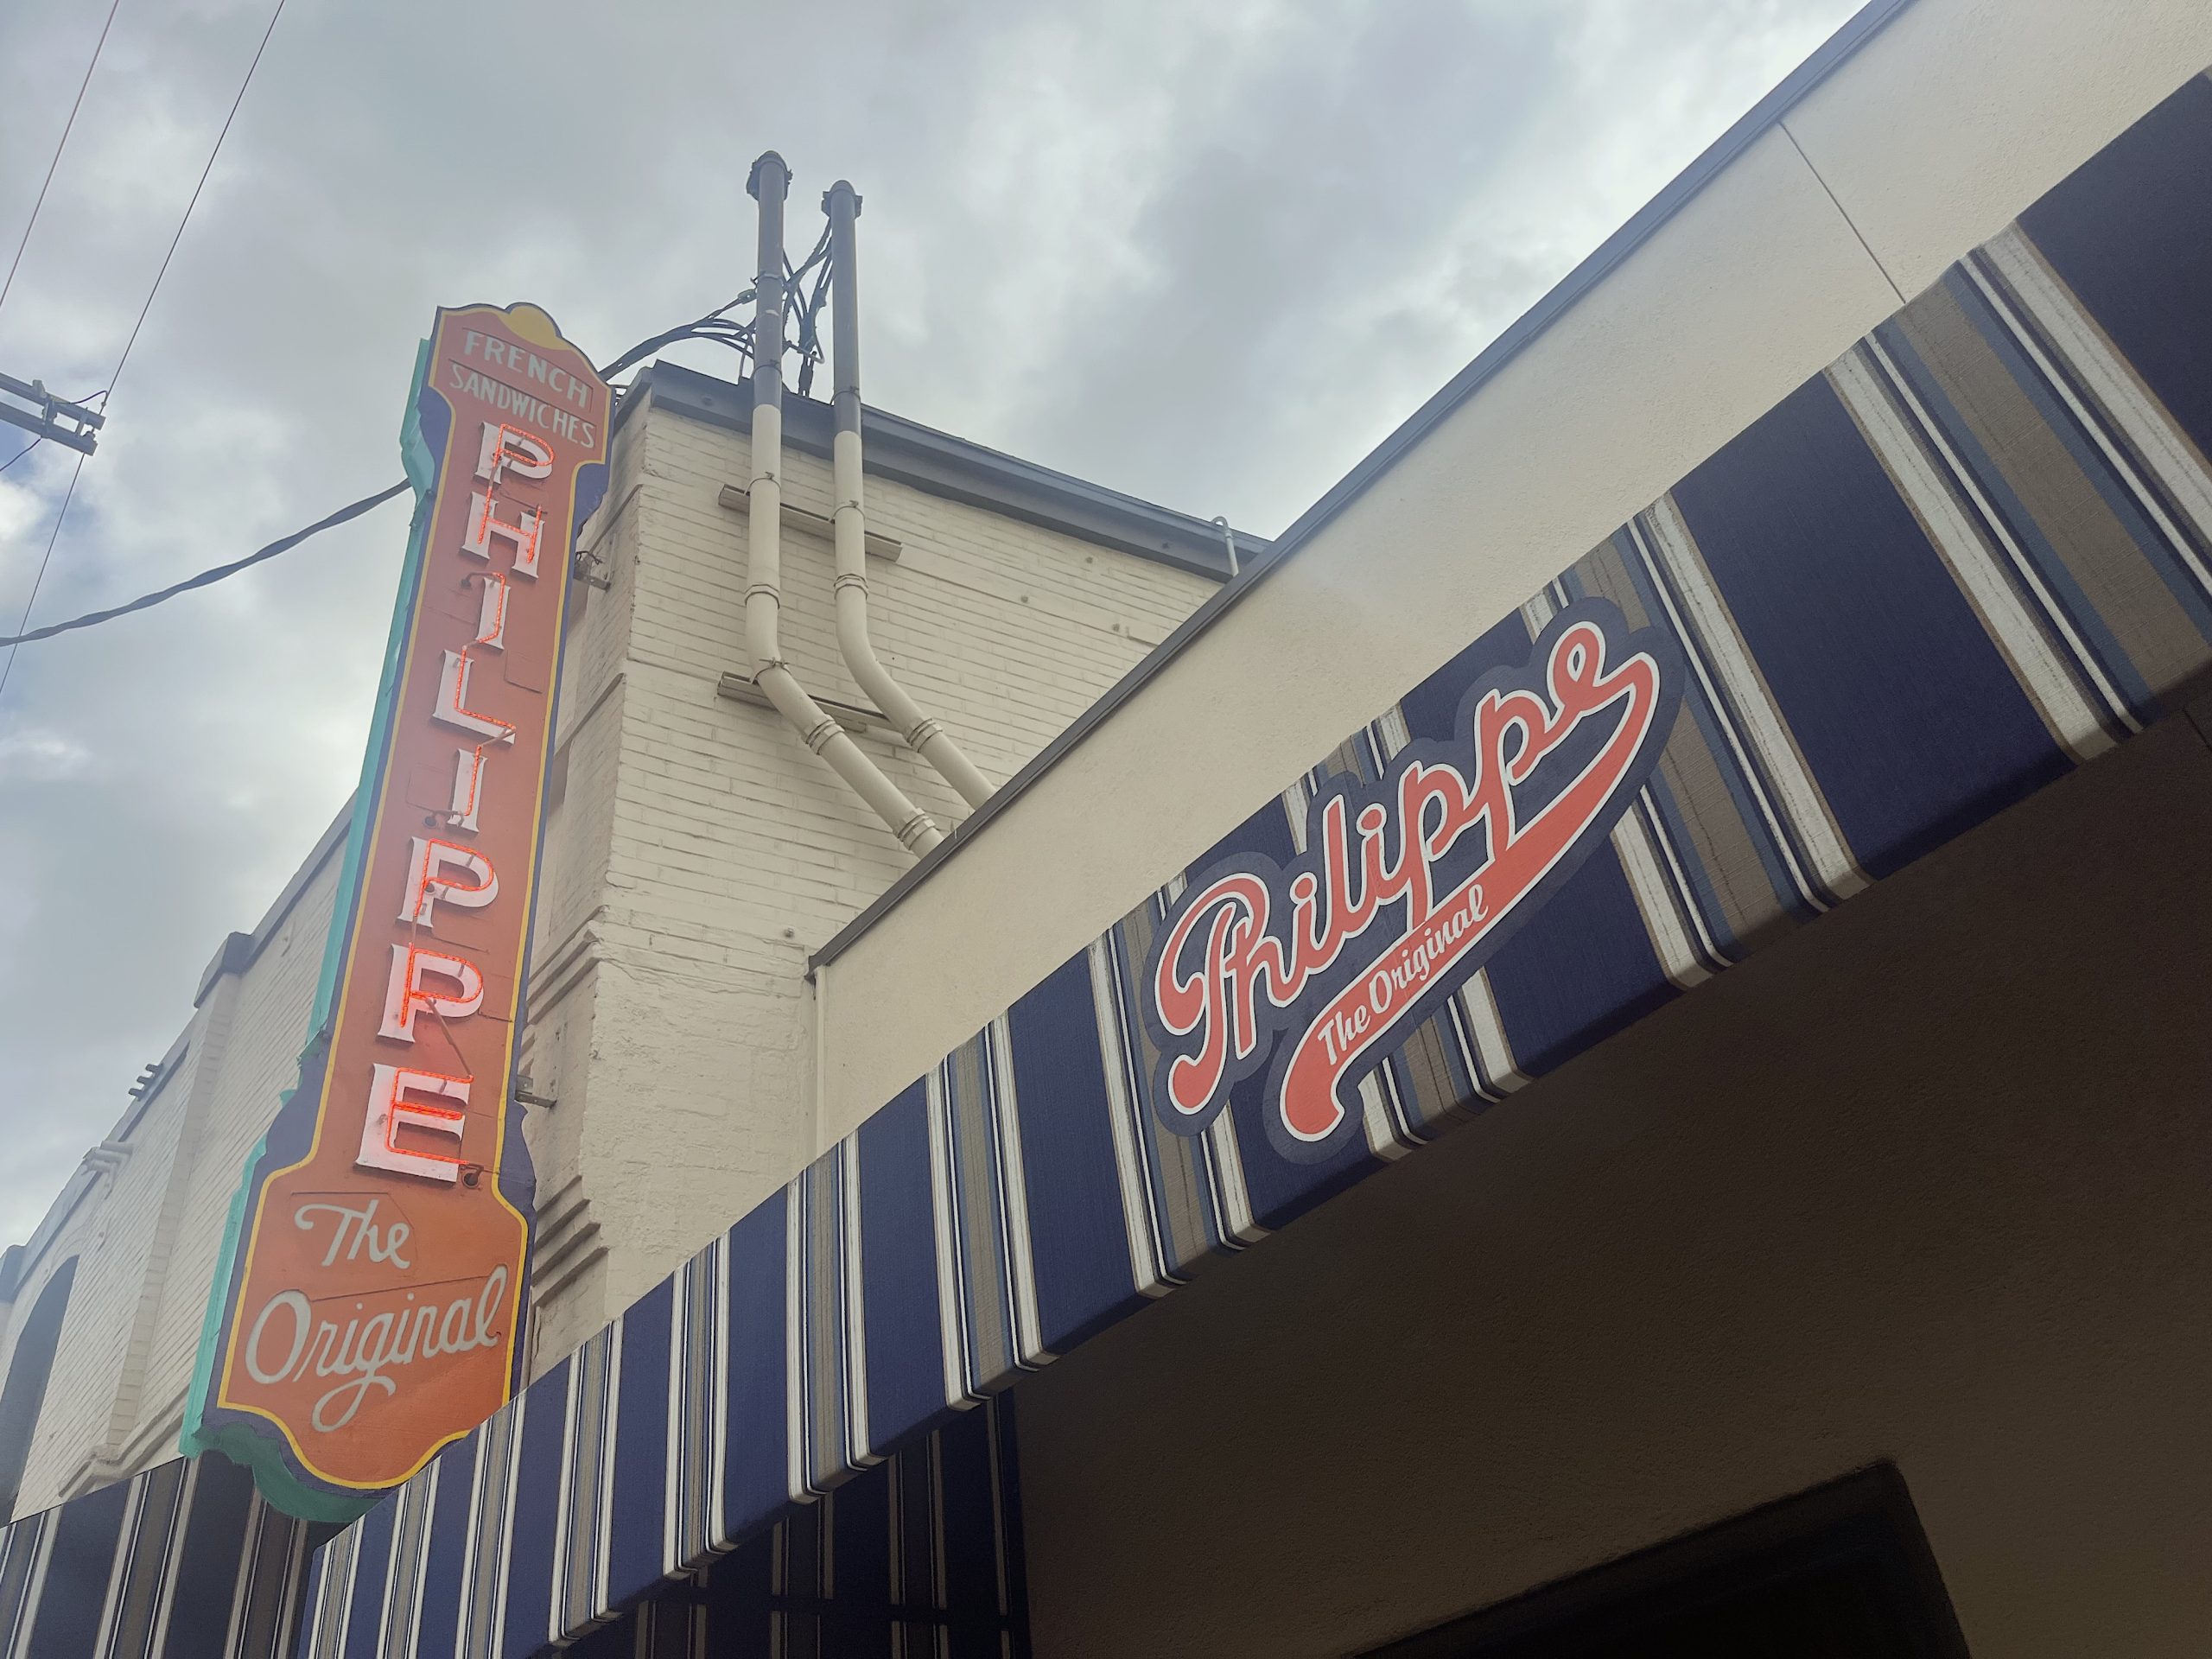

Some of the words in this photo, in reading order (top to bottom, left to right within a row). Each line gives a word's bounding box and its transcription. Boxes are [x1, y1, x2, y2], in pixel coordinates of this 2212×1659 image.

[448, 363, 595, 449] SANDWICHES
[464, 330, 589, 409] FRENCH
[354, 421, 555, 1184] PHILIPPE
[1154, 620, 1661, 1116] Philippe
[1317, 1002, 1371, 1065] The
[1368, 883, 1489, 1014] Original
[295, 1198, 410, 1269] The
[245, 1264, 508, 1433] Original
